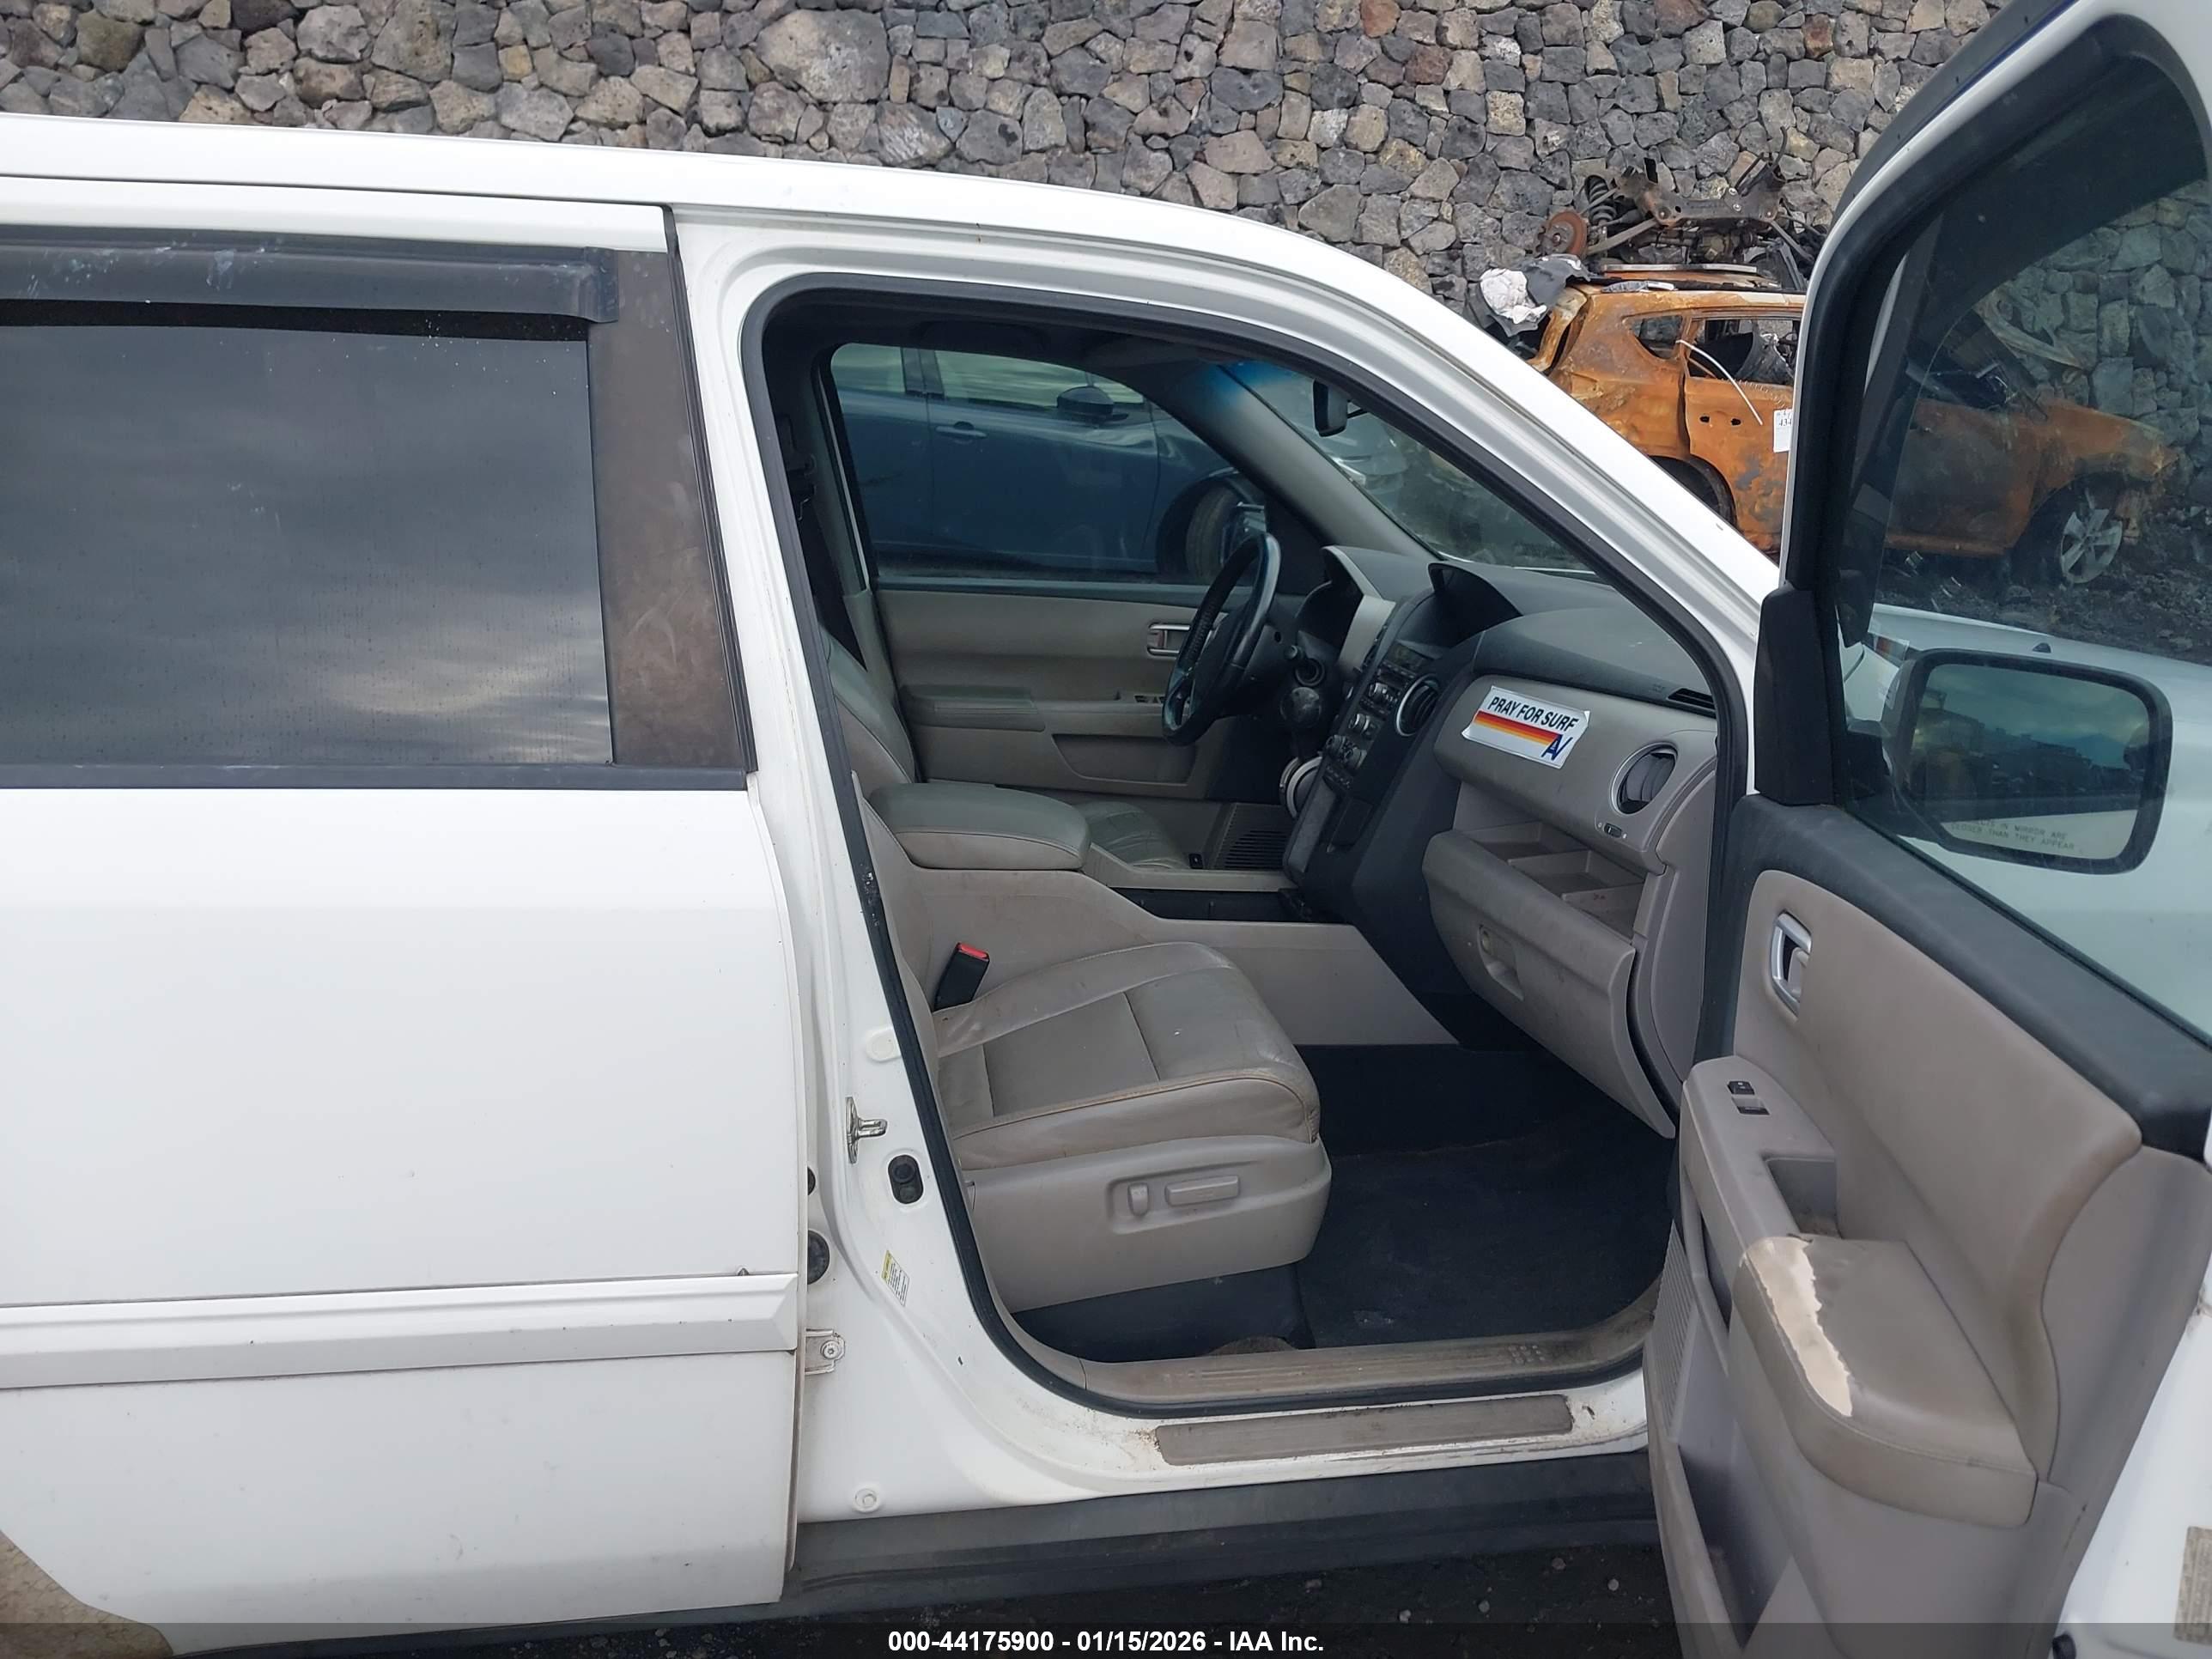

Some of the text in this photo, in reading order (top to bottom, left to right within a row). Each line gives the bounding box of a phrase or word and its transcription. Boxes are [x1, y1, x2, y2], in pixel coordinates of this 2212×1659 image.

[1487, 696, 1579, 732] PRAY FOR SURF
[2040, 838, 2075, 850] APPEAR
